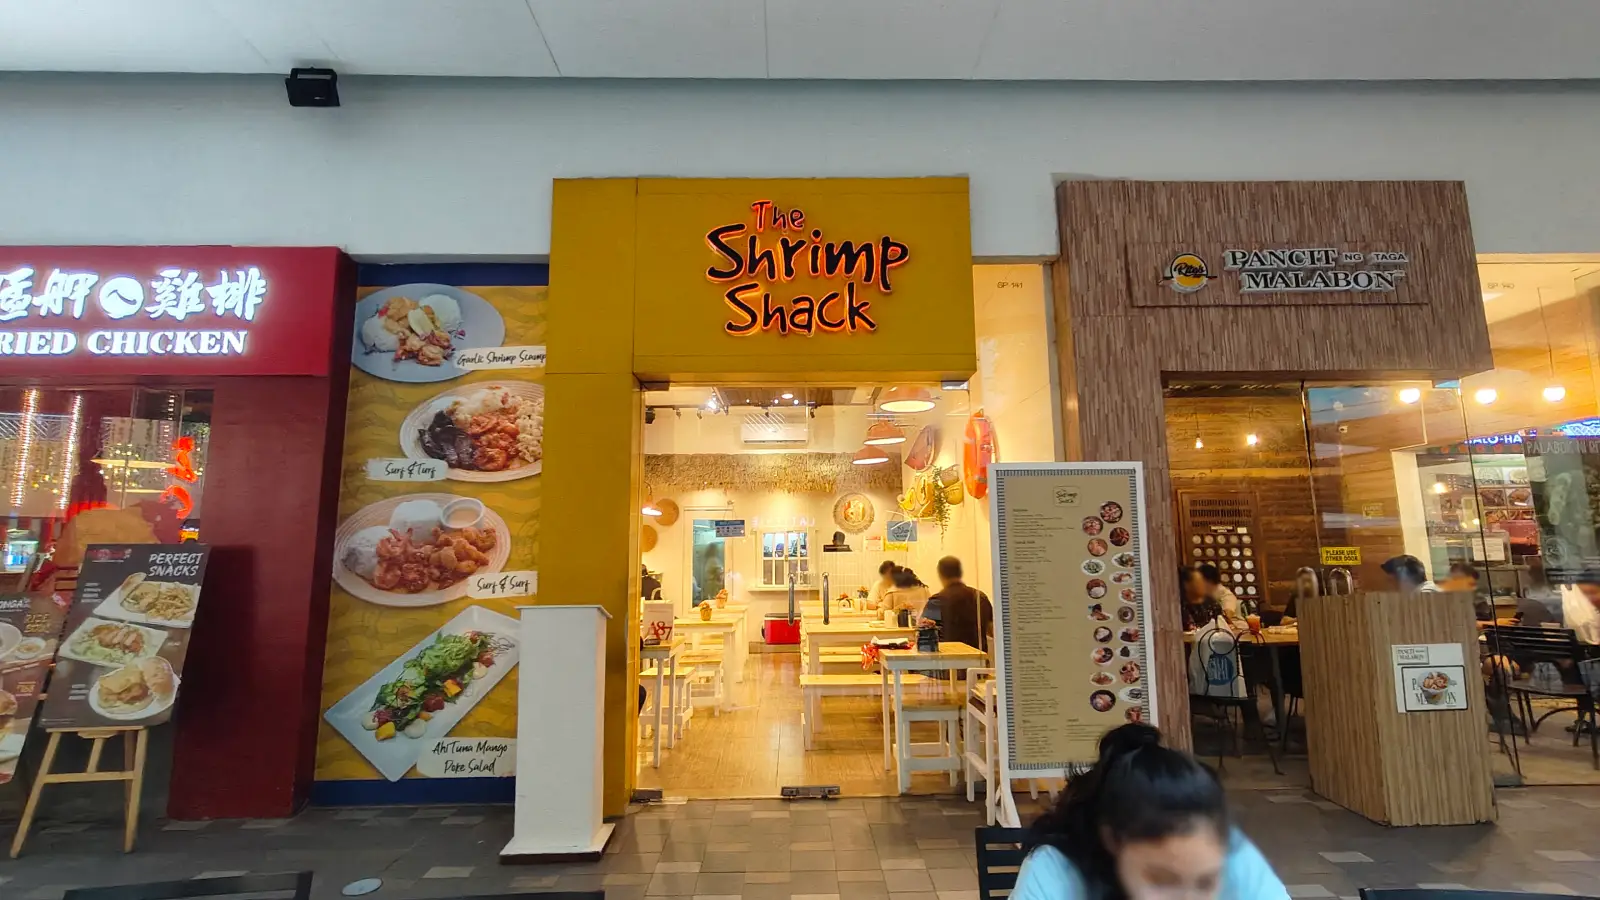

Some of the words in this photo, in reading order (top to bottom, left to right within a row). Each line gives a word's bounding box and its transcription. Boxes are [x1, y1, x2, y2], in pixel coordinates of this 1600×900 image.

[752, 200, 805, 232] The
[705, 223, 910, 293] Shrimp
[1225, 248, 1338, 269] PANCIT
[1344, 252, 1363, 263] NG
[1372, 252, 1408, 263] TAGA
[1243, 270, 1395, 291] MALABON
[725, 281, 877, 337] Shack
[87, 331, 248, 355] CHICKEN
[457, 353, 484, 366] Garlic
[487, 351, 516, 364] Shrimp
[385, 463, 405, 478] Surf
[407, 461, 417, 478] &
[417, 463, 436, 478] Turf
[149, 553, 204, 565] PERFECT
[148, 565, 199, 577] SNACKS
[477, 577, 498, 594] Surf
[499, 575, 508, 592] &
[509, 575, 531, 592] Surf
[432, 742, 448, 755] Ahi
[447, 741, 473, 754] Tuna
[476, 740, 508, 757] Mango
[444, 760, 466, 774] Poke
[468, 758, 497, 775] Salad
